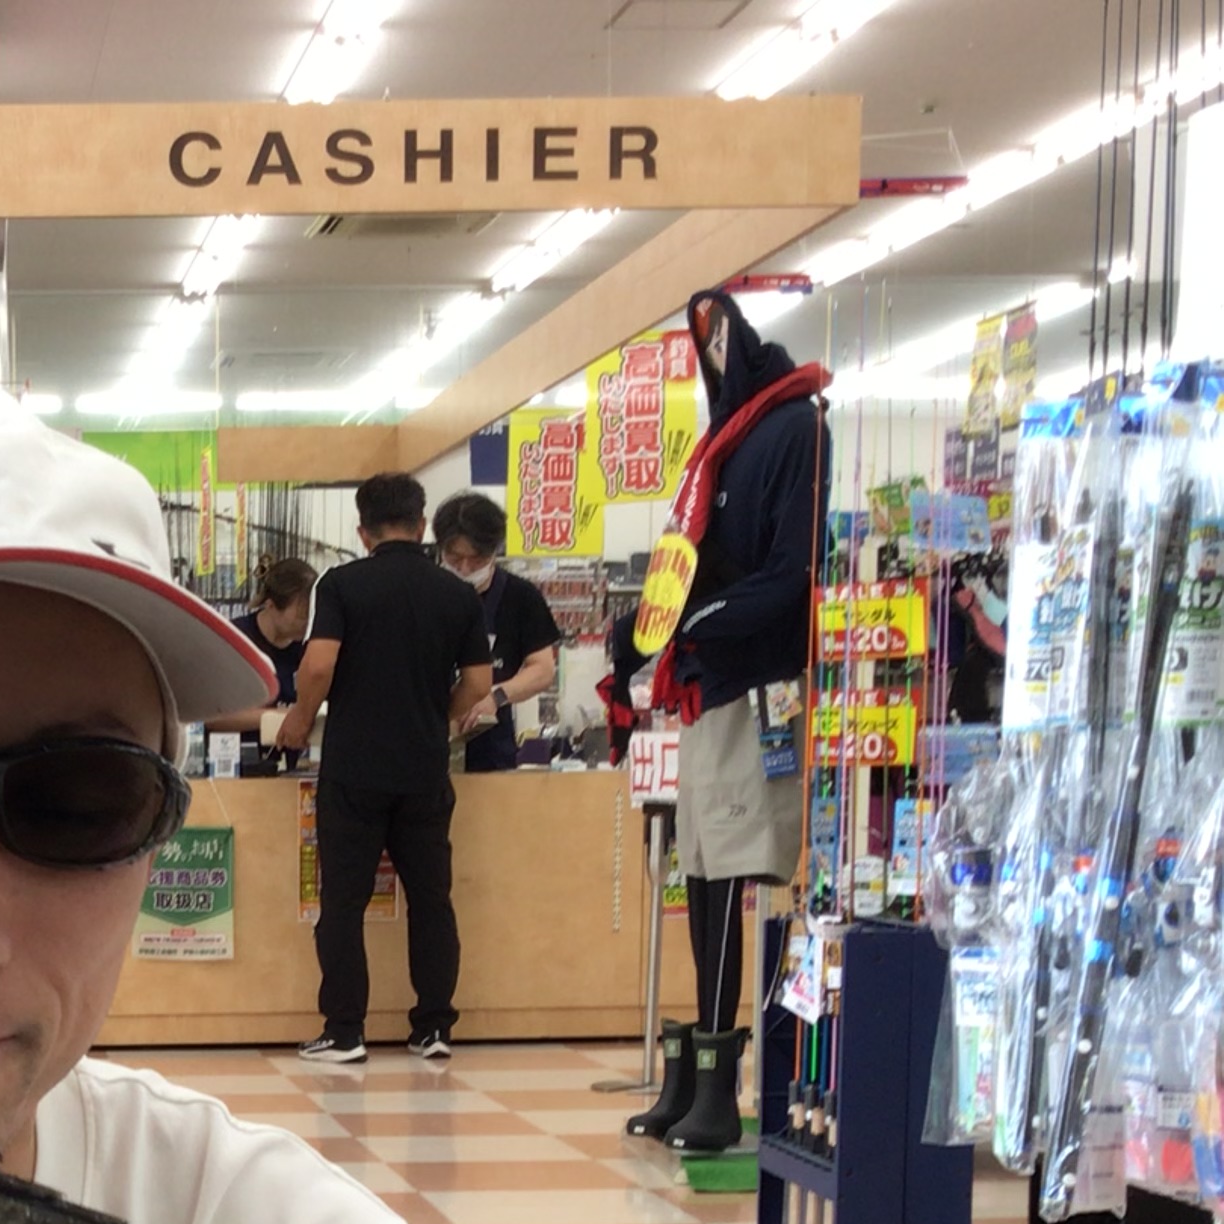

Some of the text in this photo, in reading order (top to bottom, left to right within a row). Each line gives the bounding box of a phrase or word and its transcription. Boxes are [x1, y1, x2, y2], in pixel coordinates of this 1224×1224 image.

[168, 126, 660, 187] CASHIER
[623, 343, 664, 494] 高価買取
[540, 419, 576, 548] 高価買取
[153, 889, 215, 912] 取扱店
